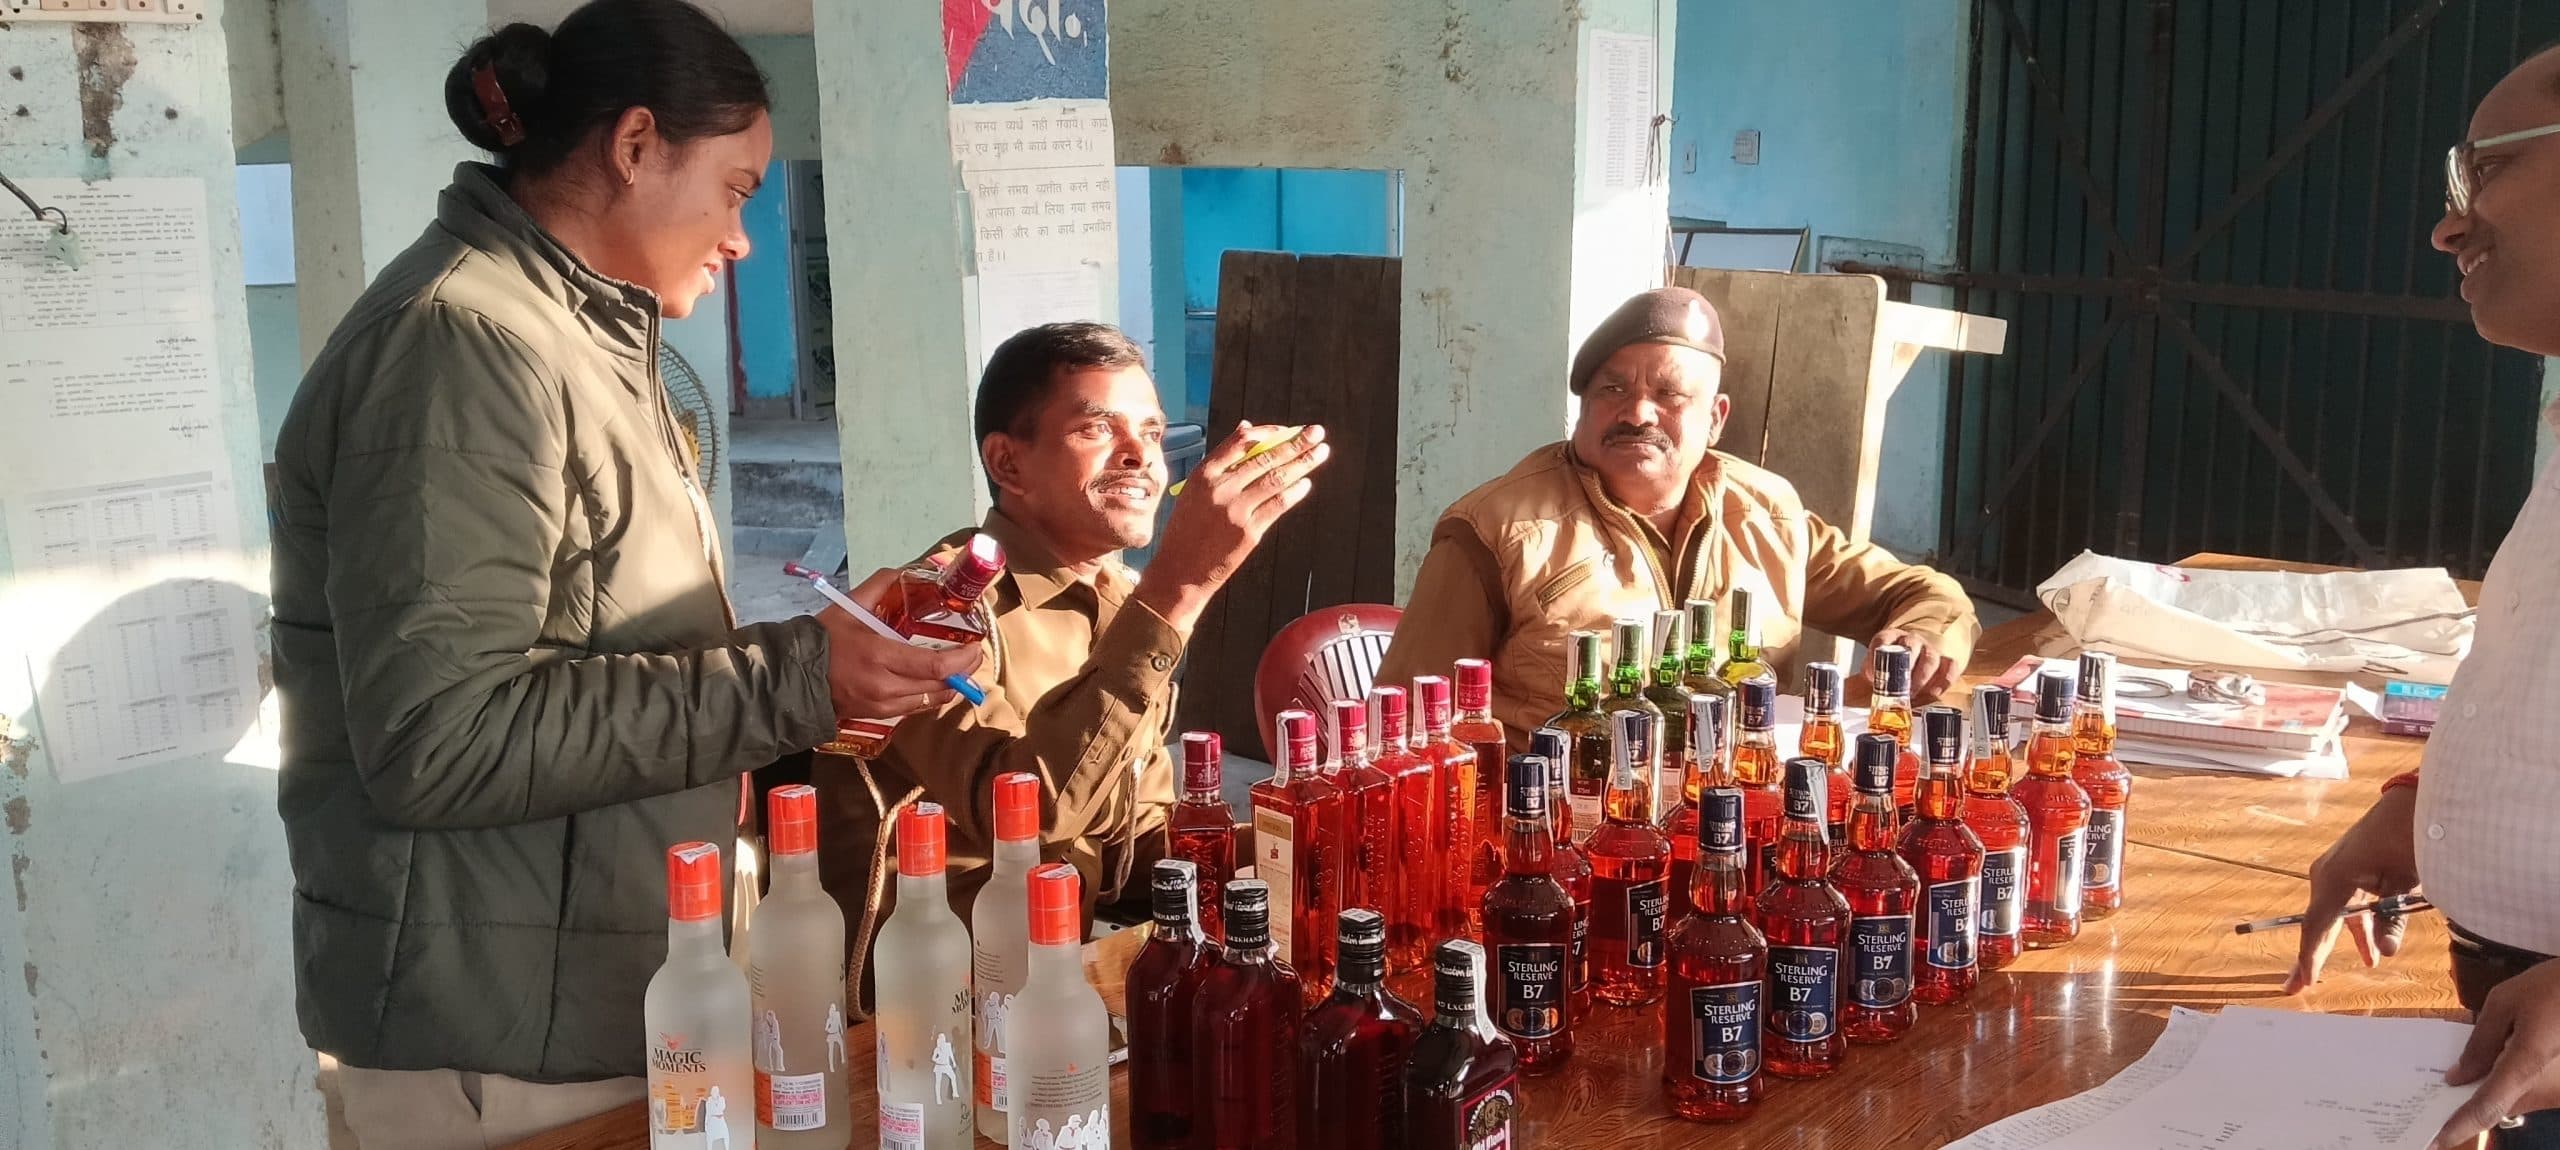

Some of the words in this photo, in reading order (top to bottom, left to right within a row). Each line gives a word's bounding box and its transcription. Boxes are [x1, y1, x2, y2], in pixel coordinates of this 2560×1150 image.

[2088, 823, 2112, 834] LING
[2087, 842, 2098, 856] 7
[1996, 885, 2014, 901] B7
[1652, 914, 1666, 932] B7
[1857, 931, 1907, 945] STERLING
[1571, 940, 1581, 956] 7
[1863, 942, 1903, 953] RESERVE
[1508, 960, 1558, 973] STERLING
[1774, 962, 1828, 977] STERLING
[1873, 955, 1894, 970] B7
[1513, 971, 1553, 982] RESERVE
[1780, 973, 1823, 985] RESERVE
[1522, 984, 1545, 999] B7
[1790, 986, 1812, 1002] B7
[1704, 998, 1756, 1017] STERLING
[1711, 1011, 1752, 1024] RESERVE
[1721, 1025, 1743, 1043] B7
[653, 1047, 702, 1065] MAGIC
[652, 1057, 707, 1073] MOMENTS
